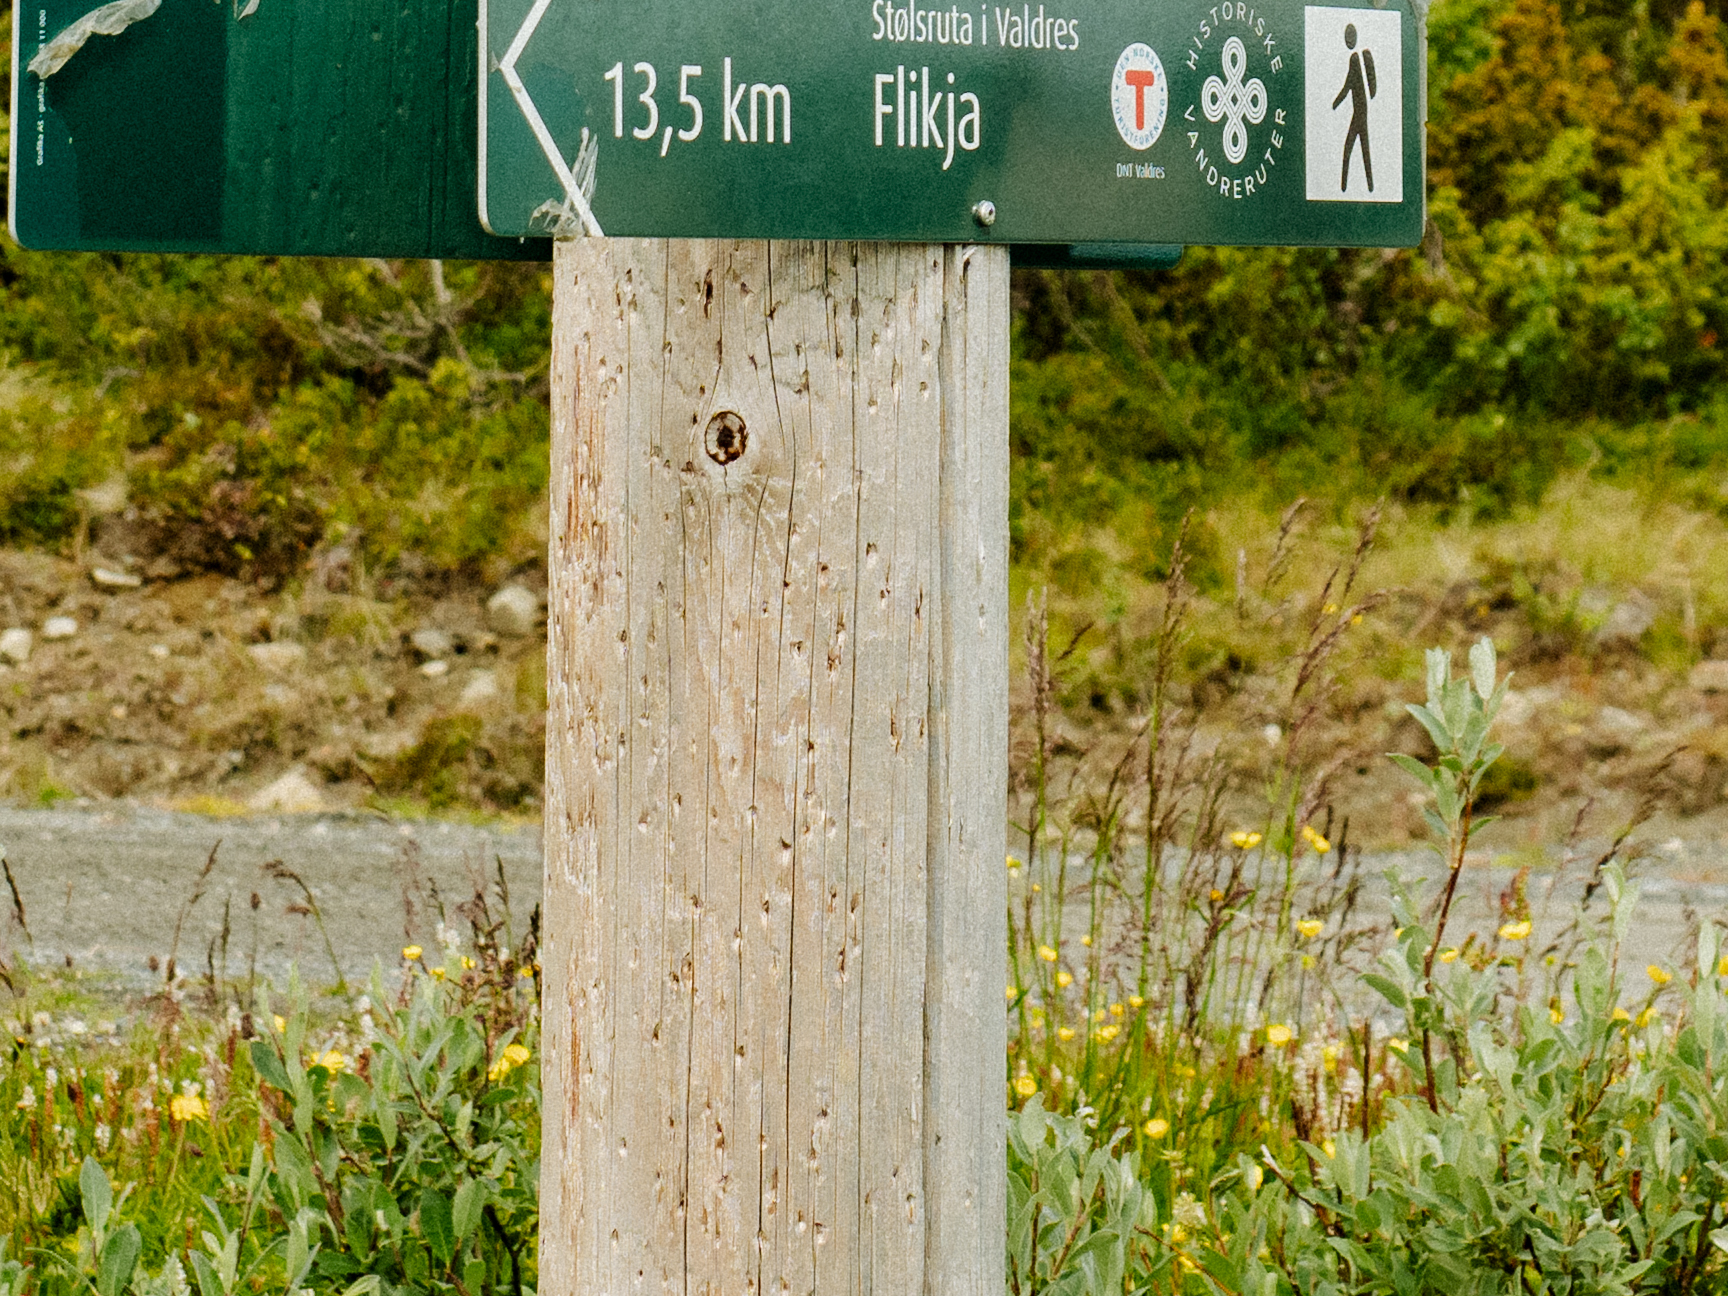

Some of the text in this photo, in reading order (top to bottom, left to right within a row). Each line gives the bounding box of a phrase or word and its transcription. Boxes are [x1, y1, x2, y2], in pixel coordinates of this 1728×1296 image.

[980, 5, 988, 46] i
[995, 4, 1080, 51] Valdres
[1186, 1, 1284, 75] HISTORISKE
[603, 56, 792, 158] 13,5 km
[873, 64, 982, 171] Flikja
[1125, 69, 1155, 131] T
[1116, 161, 1166, 180] DNT Valdres
[1183, 104, 1287, 199] VANDRERUTER
